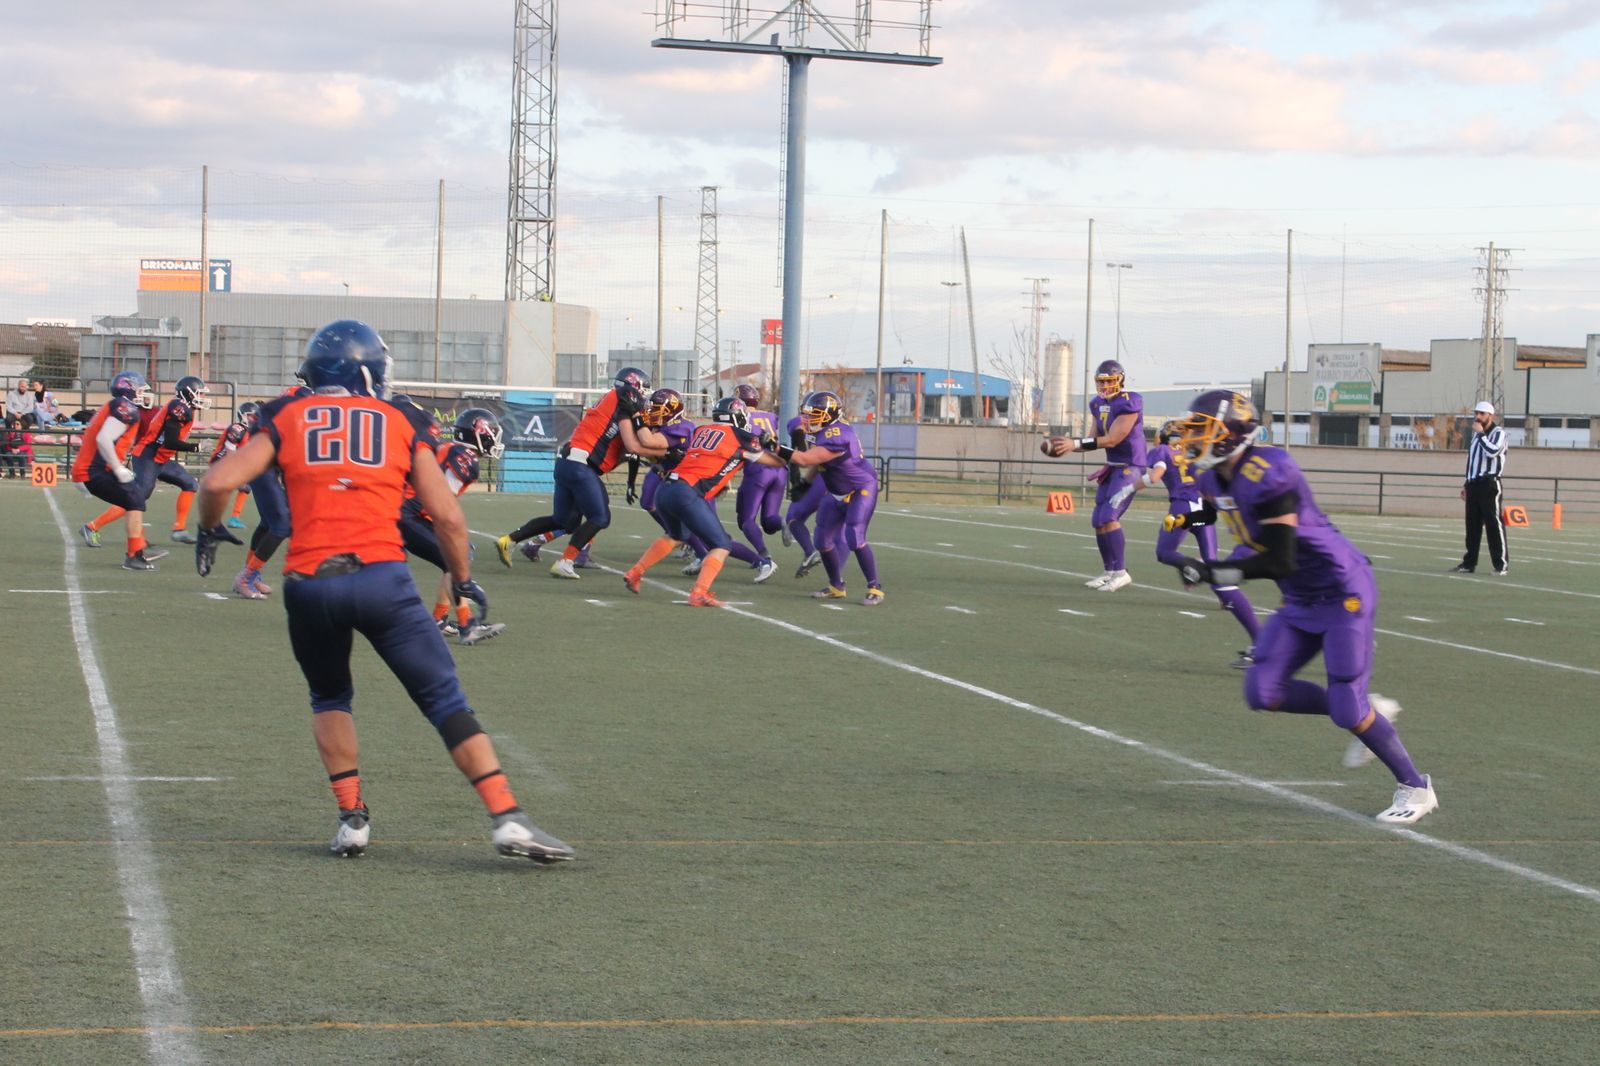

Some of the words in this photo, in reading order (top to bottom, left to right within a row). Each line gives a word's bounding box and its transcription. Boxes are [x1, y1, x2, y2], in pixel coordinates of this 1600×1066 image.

[304, 404, 387, 468] 20
[691, 428, 725, 451] 60
[34, 466, 54, 484] 30
[1053, 494, 1071, 511] 10
[1509, 508, 1527, 524] G
